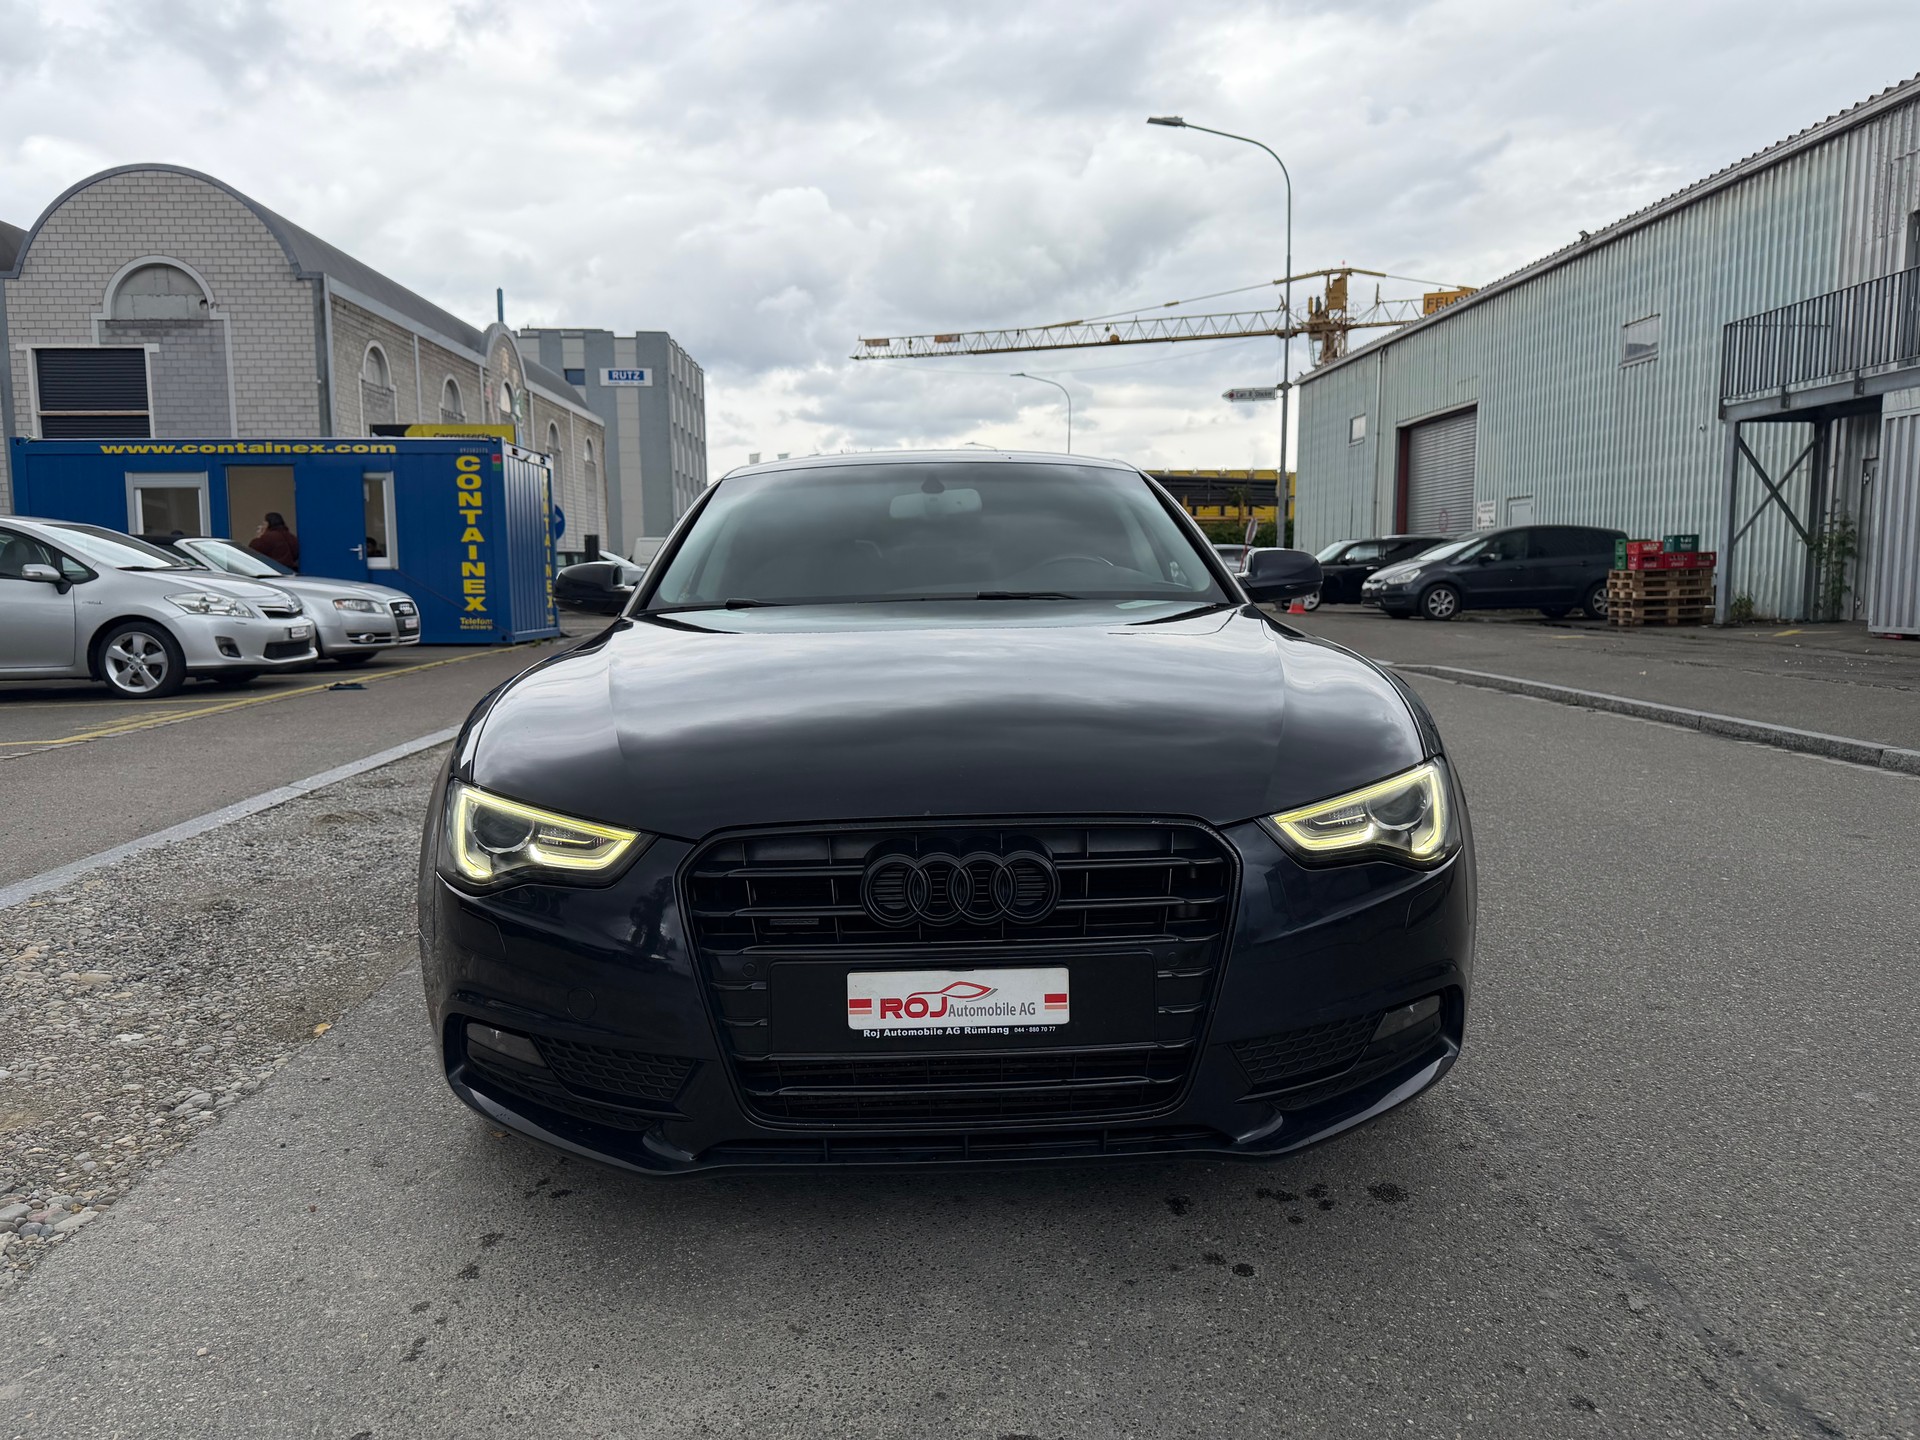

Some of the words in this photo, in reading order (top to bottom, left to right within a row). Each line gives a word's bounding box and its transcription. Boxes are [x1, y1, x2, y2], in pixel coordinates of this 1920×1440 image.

[612, 371, 641, 380] RUTZ
[100, 442, 397, 455] www.containex.com
[456, 455, 488, 612] CONTAINEX
[880, 996, 948, 1019] ROJ
[948, 1002, 1016, 1018] Automobile
[1019, 1002, 1036, 1015] AG
[863, 1029, 880, 1039] Roj
[884, 1027, 943, 1037] Automobile
[946, 1027, 961, 1035] AG
[964, 1026, 1010, 1035] Rümlang
